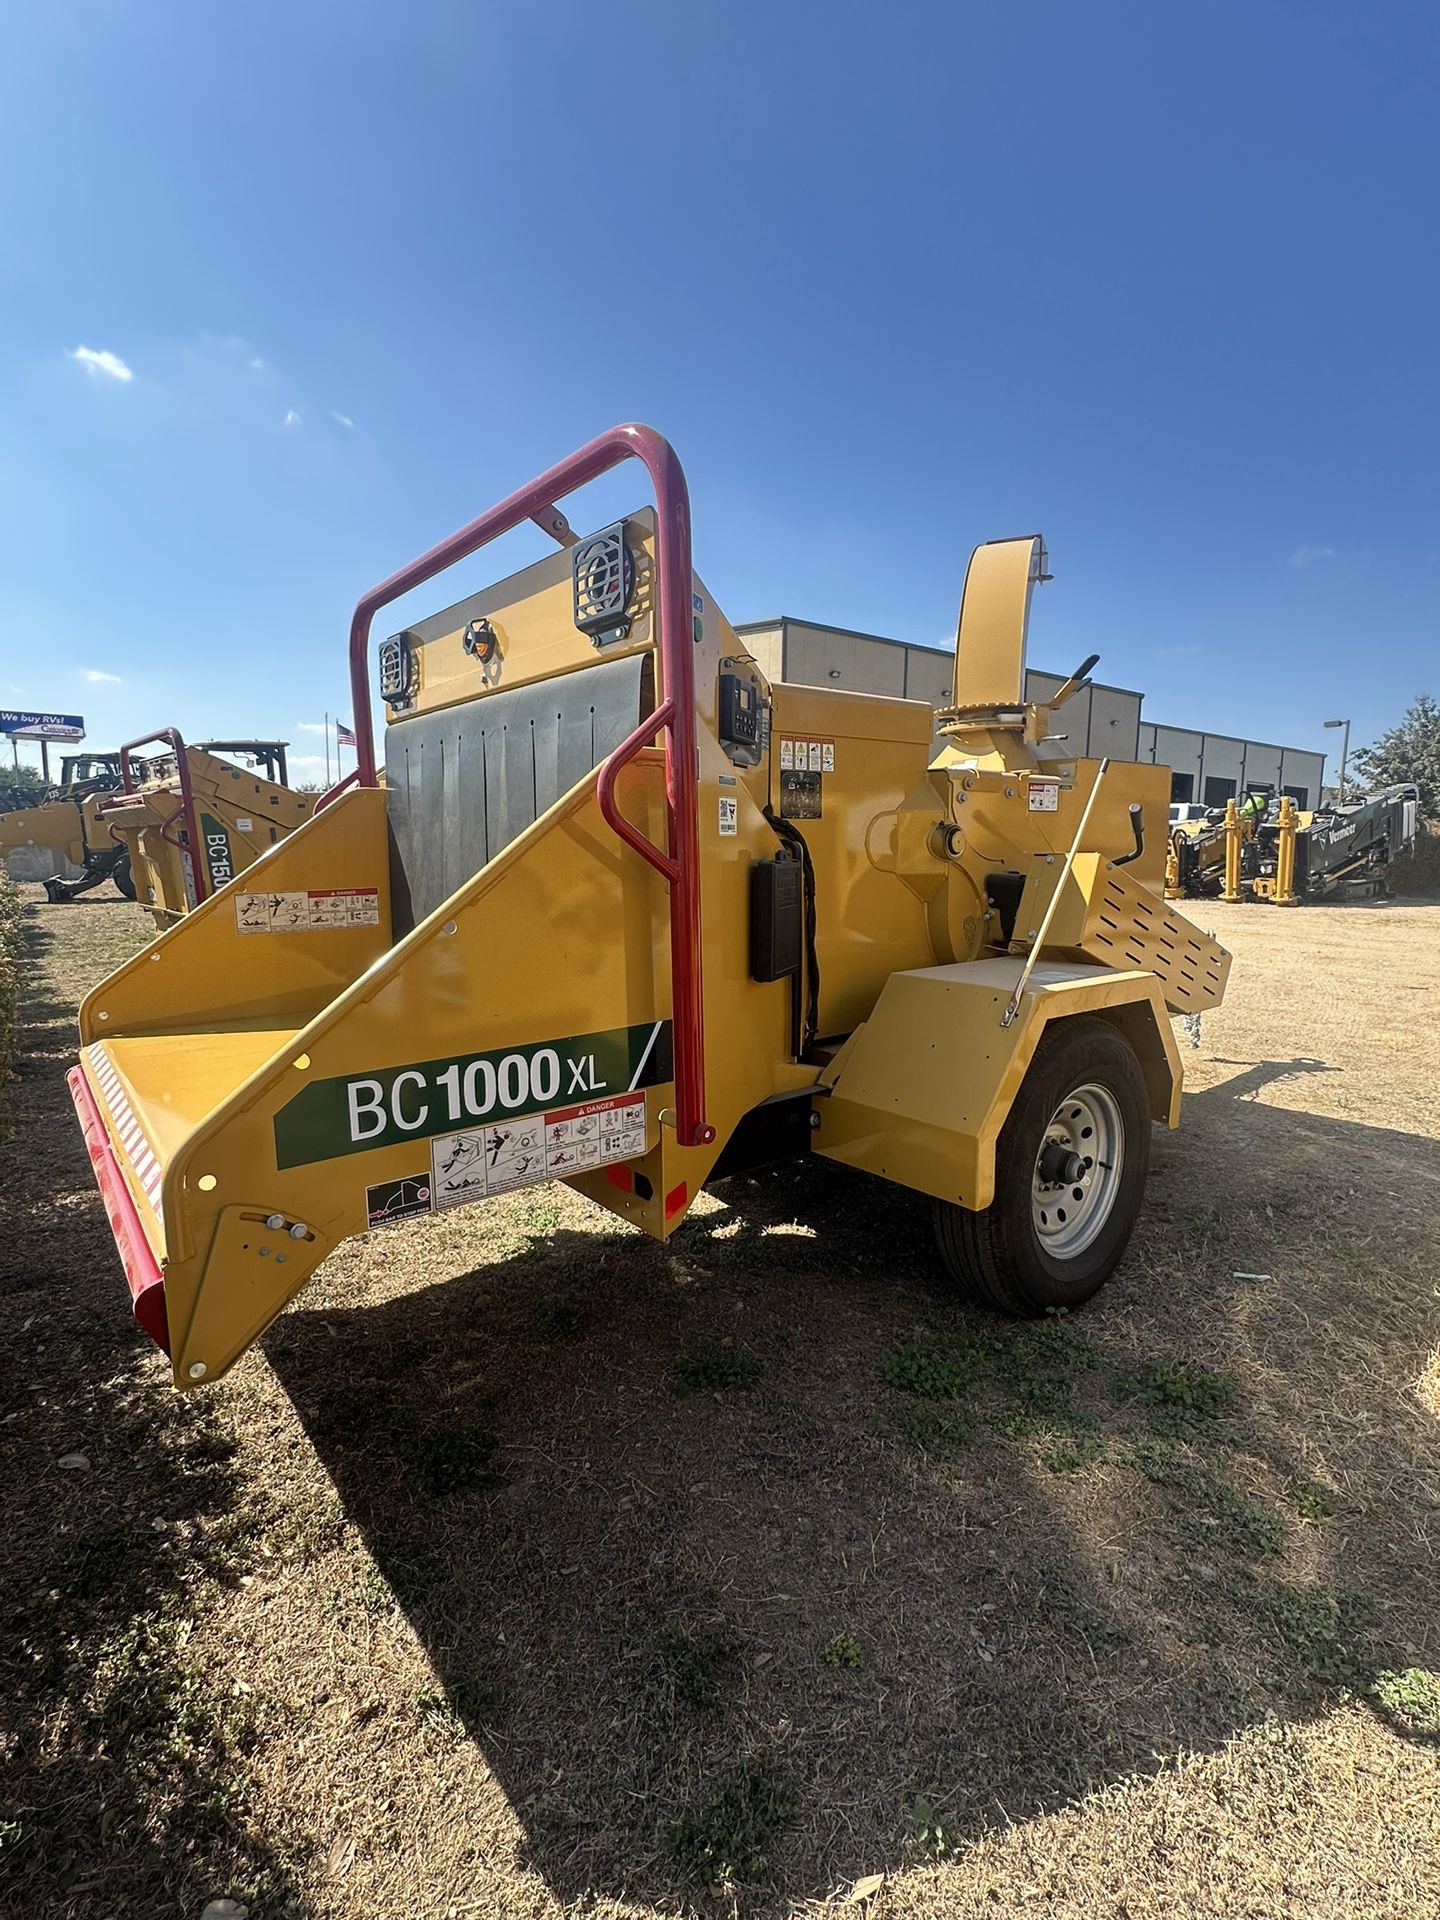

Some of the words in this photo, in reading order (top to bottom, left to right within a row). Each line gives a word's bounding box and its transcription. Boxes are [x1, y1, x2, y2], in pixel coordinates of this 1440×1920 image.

[1, 712, 18, 721] We
[21, 714, 40, 724] buy
[42, 716, 65, 724] RVs!
[1328, 823, 1356, 845] Vermeer
[586, 1101, 616, 1115] DANGER
